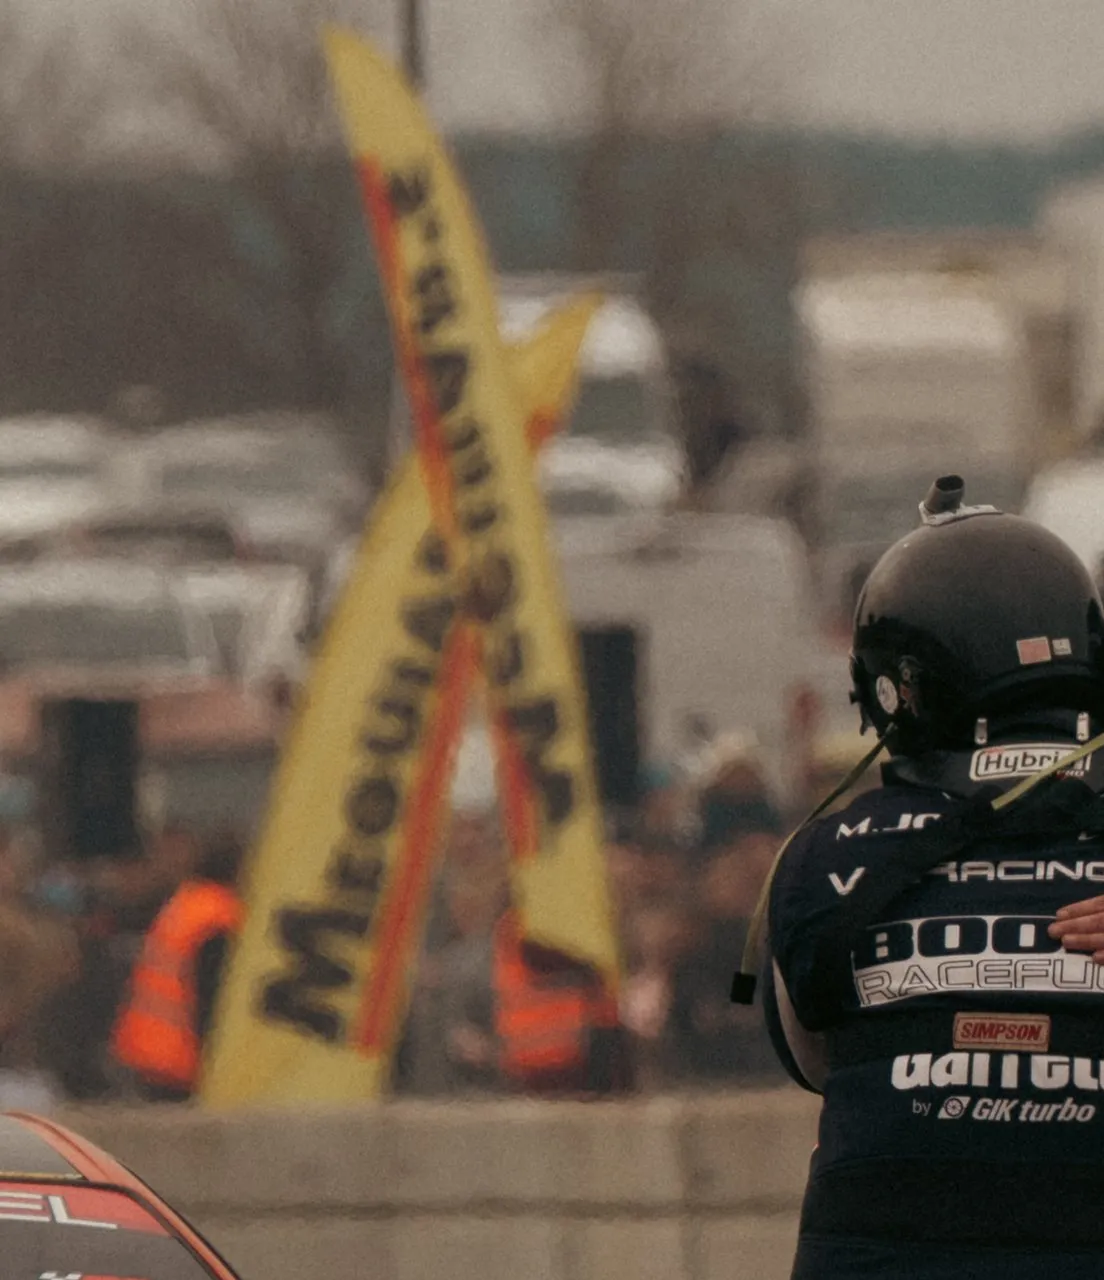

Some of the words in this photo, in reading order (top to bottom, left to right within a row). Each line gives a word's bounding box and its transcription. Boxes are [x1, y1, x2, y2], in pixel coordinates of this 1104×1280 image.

[984, 751, 1076, 772] Hybri
[961, 1022, 1042, 1041] SIMPSON
[912, 1099, 931, 1117] by
[1019, 1097, 1096, 1122] turbo
